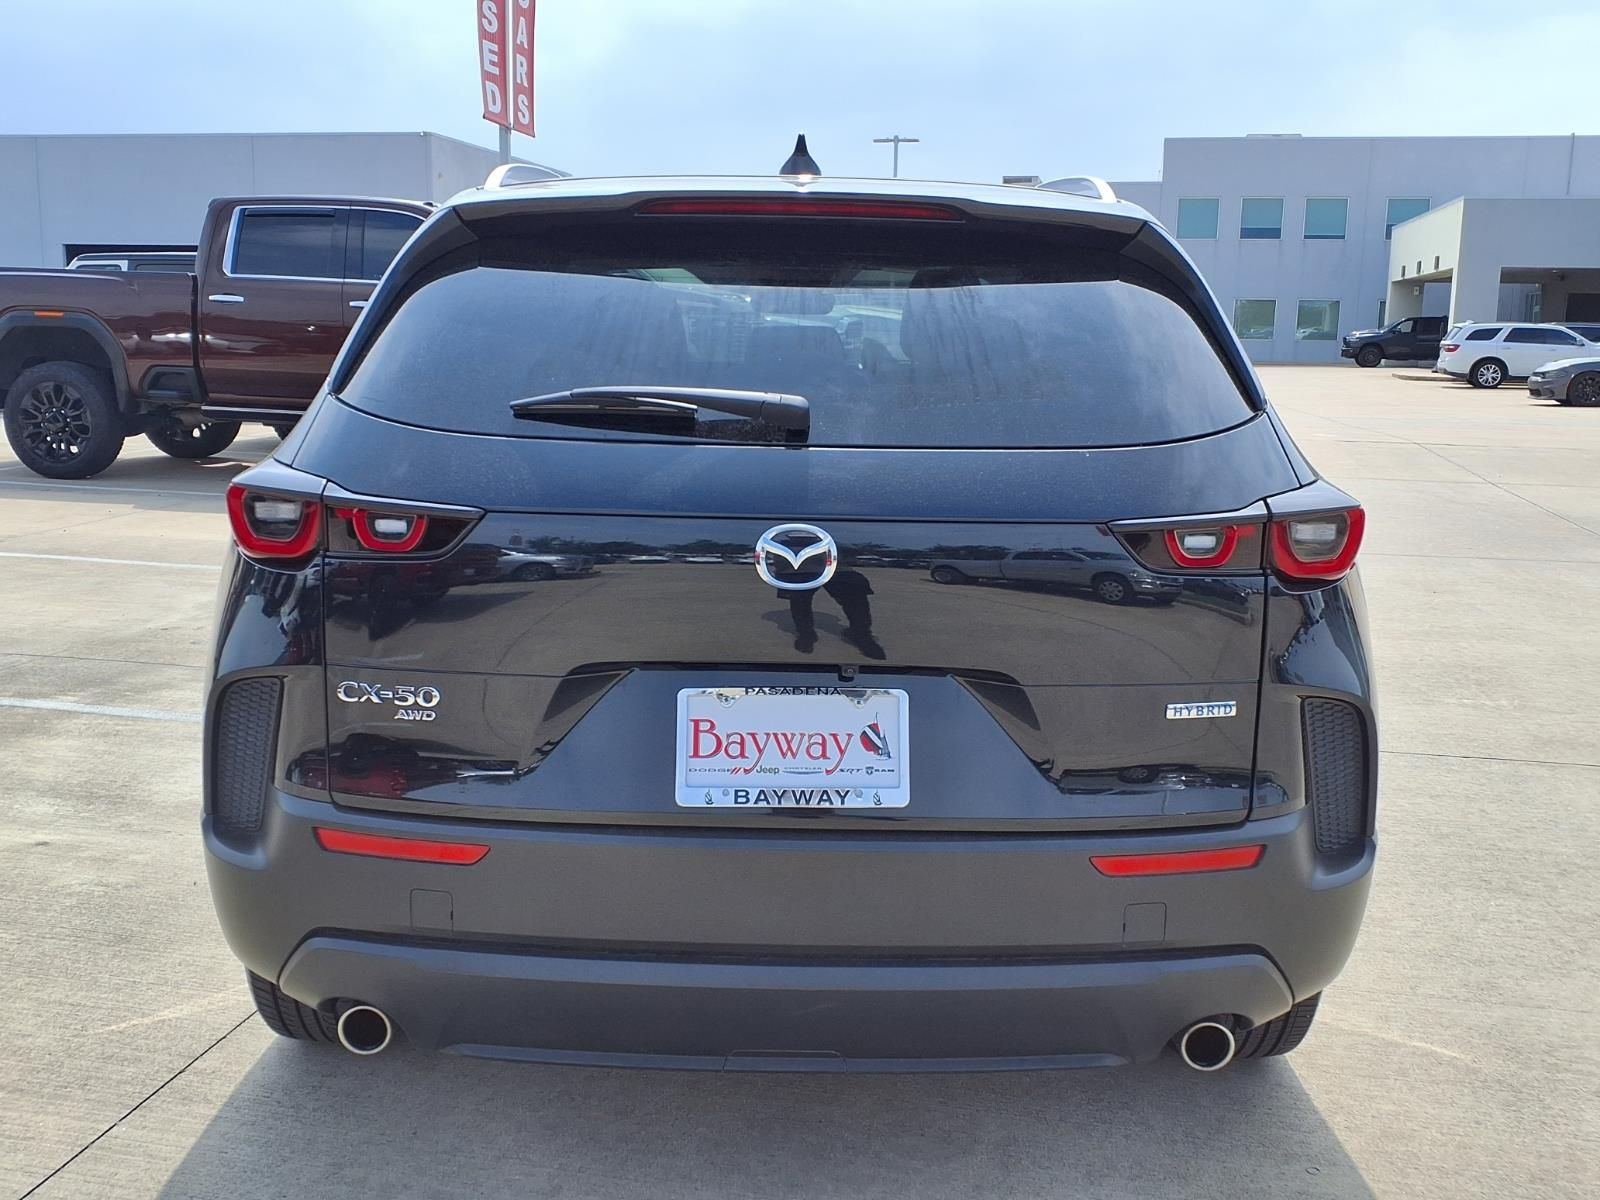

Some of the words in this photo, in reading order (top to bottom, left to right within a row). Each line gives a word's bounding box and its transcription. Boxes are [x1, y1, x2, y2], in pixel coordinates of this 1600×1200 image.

[336, 681, 440, 707] CX-50
[744, 687, 842, 696] PASADENA
[393, 709, 437, 721] AWD
[1173, 703, 1233, 717] HYBRID
[688, 718, 854, 776] Bayway
[756, 765, 780, 775] Jeep
[733, 789, 851, 805] BAYWAY
